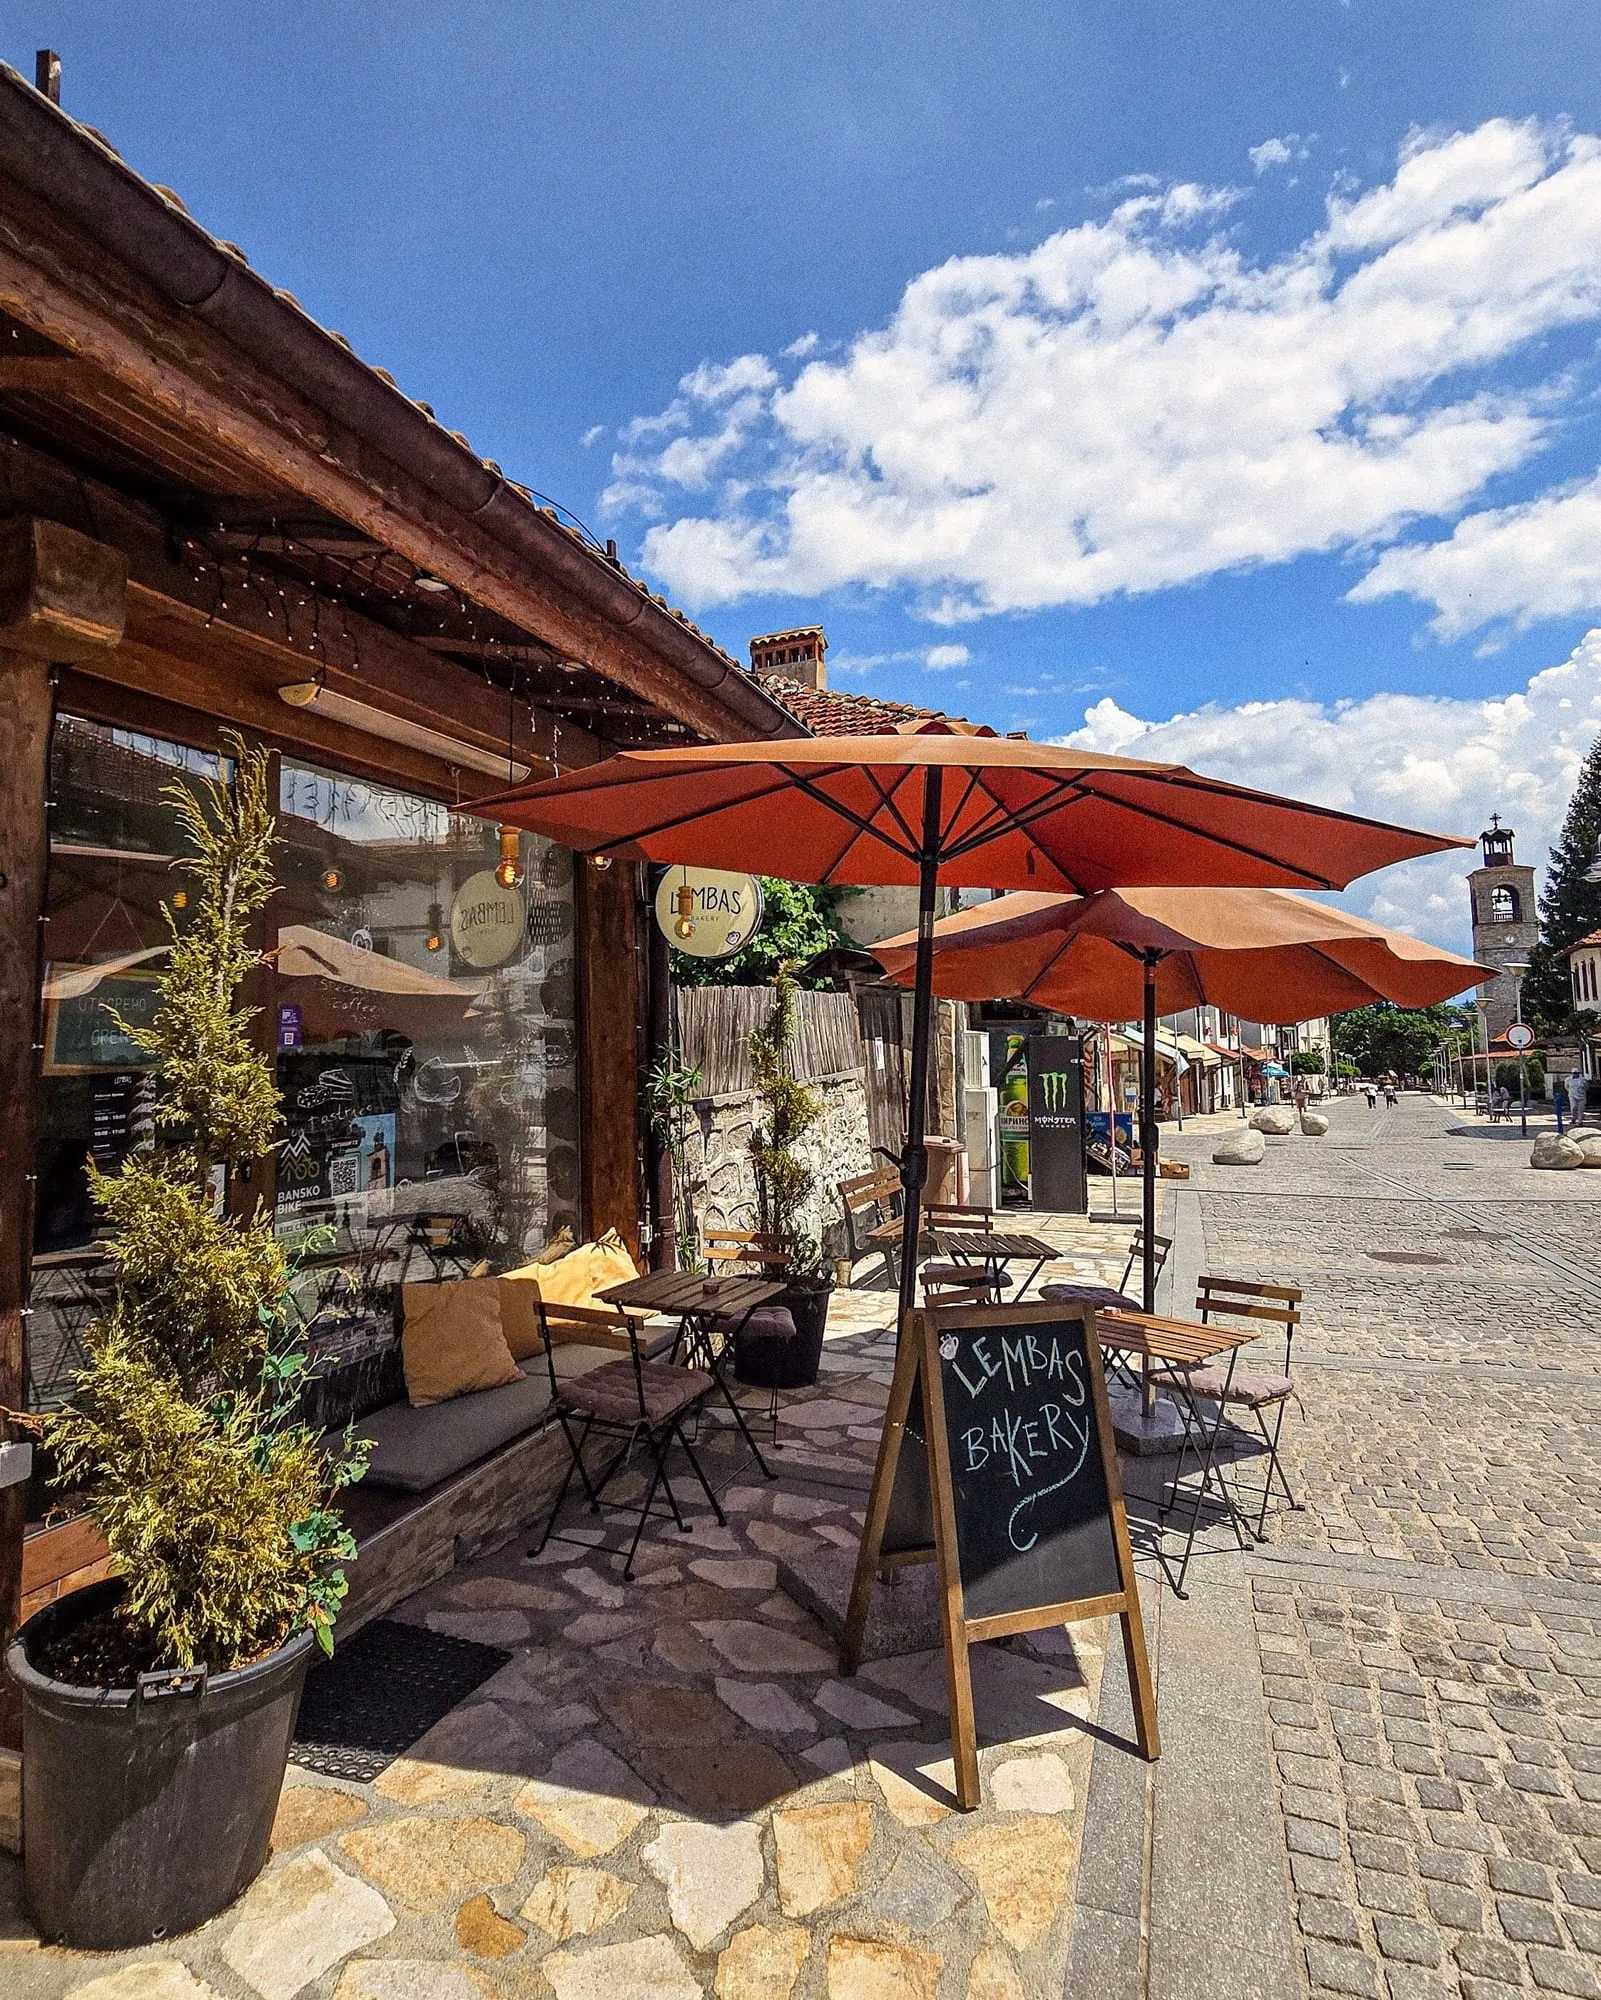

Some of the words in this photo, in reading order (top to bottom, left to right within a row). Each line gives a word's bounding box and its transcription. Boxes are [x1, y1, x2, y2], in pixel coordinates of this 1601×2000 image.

[670, 886, 742, 915] LMBAS
[1034, 1115, 1077, 1125] MONSTER
[277, 1185, 320, 1203] BANSKO
[277, 1200, 302, 1215] BIKE
[952, 1335, 1086, 1406] LEMBAS
[960, 1403, 1089, 1551] BAKERY
